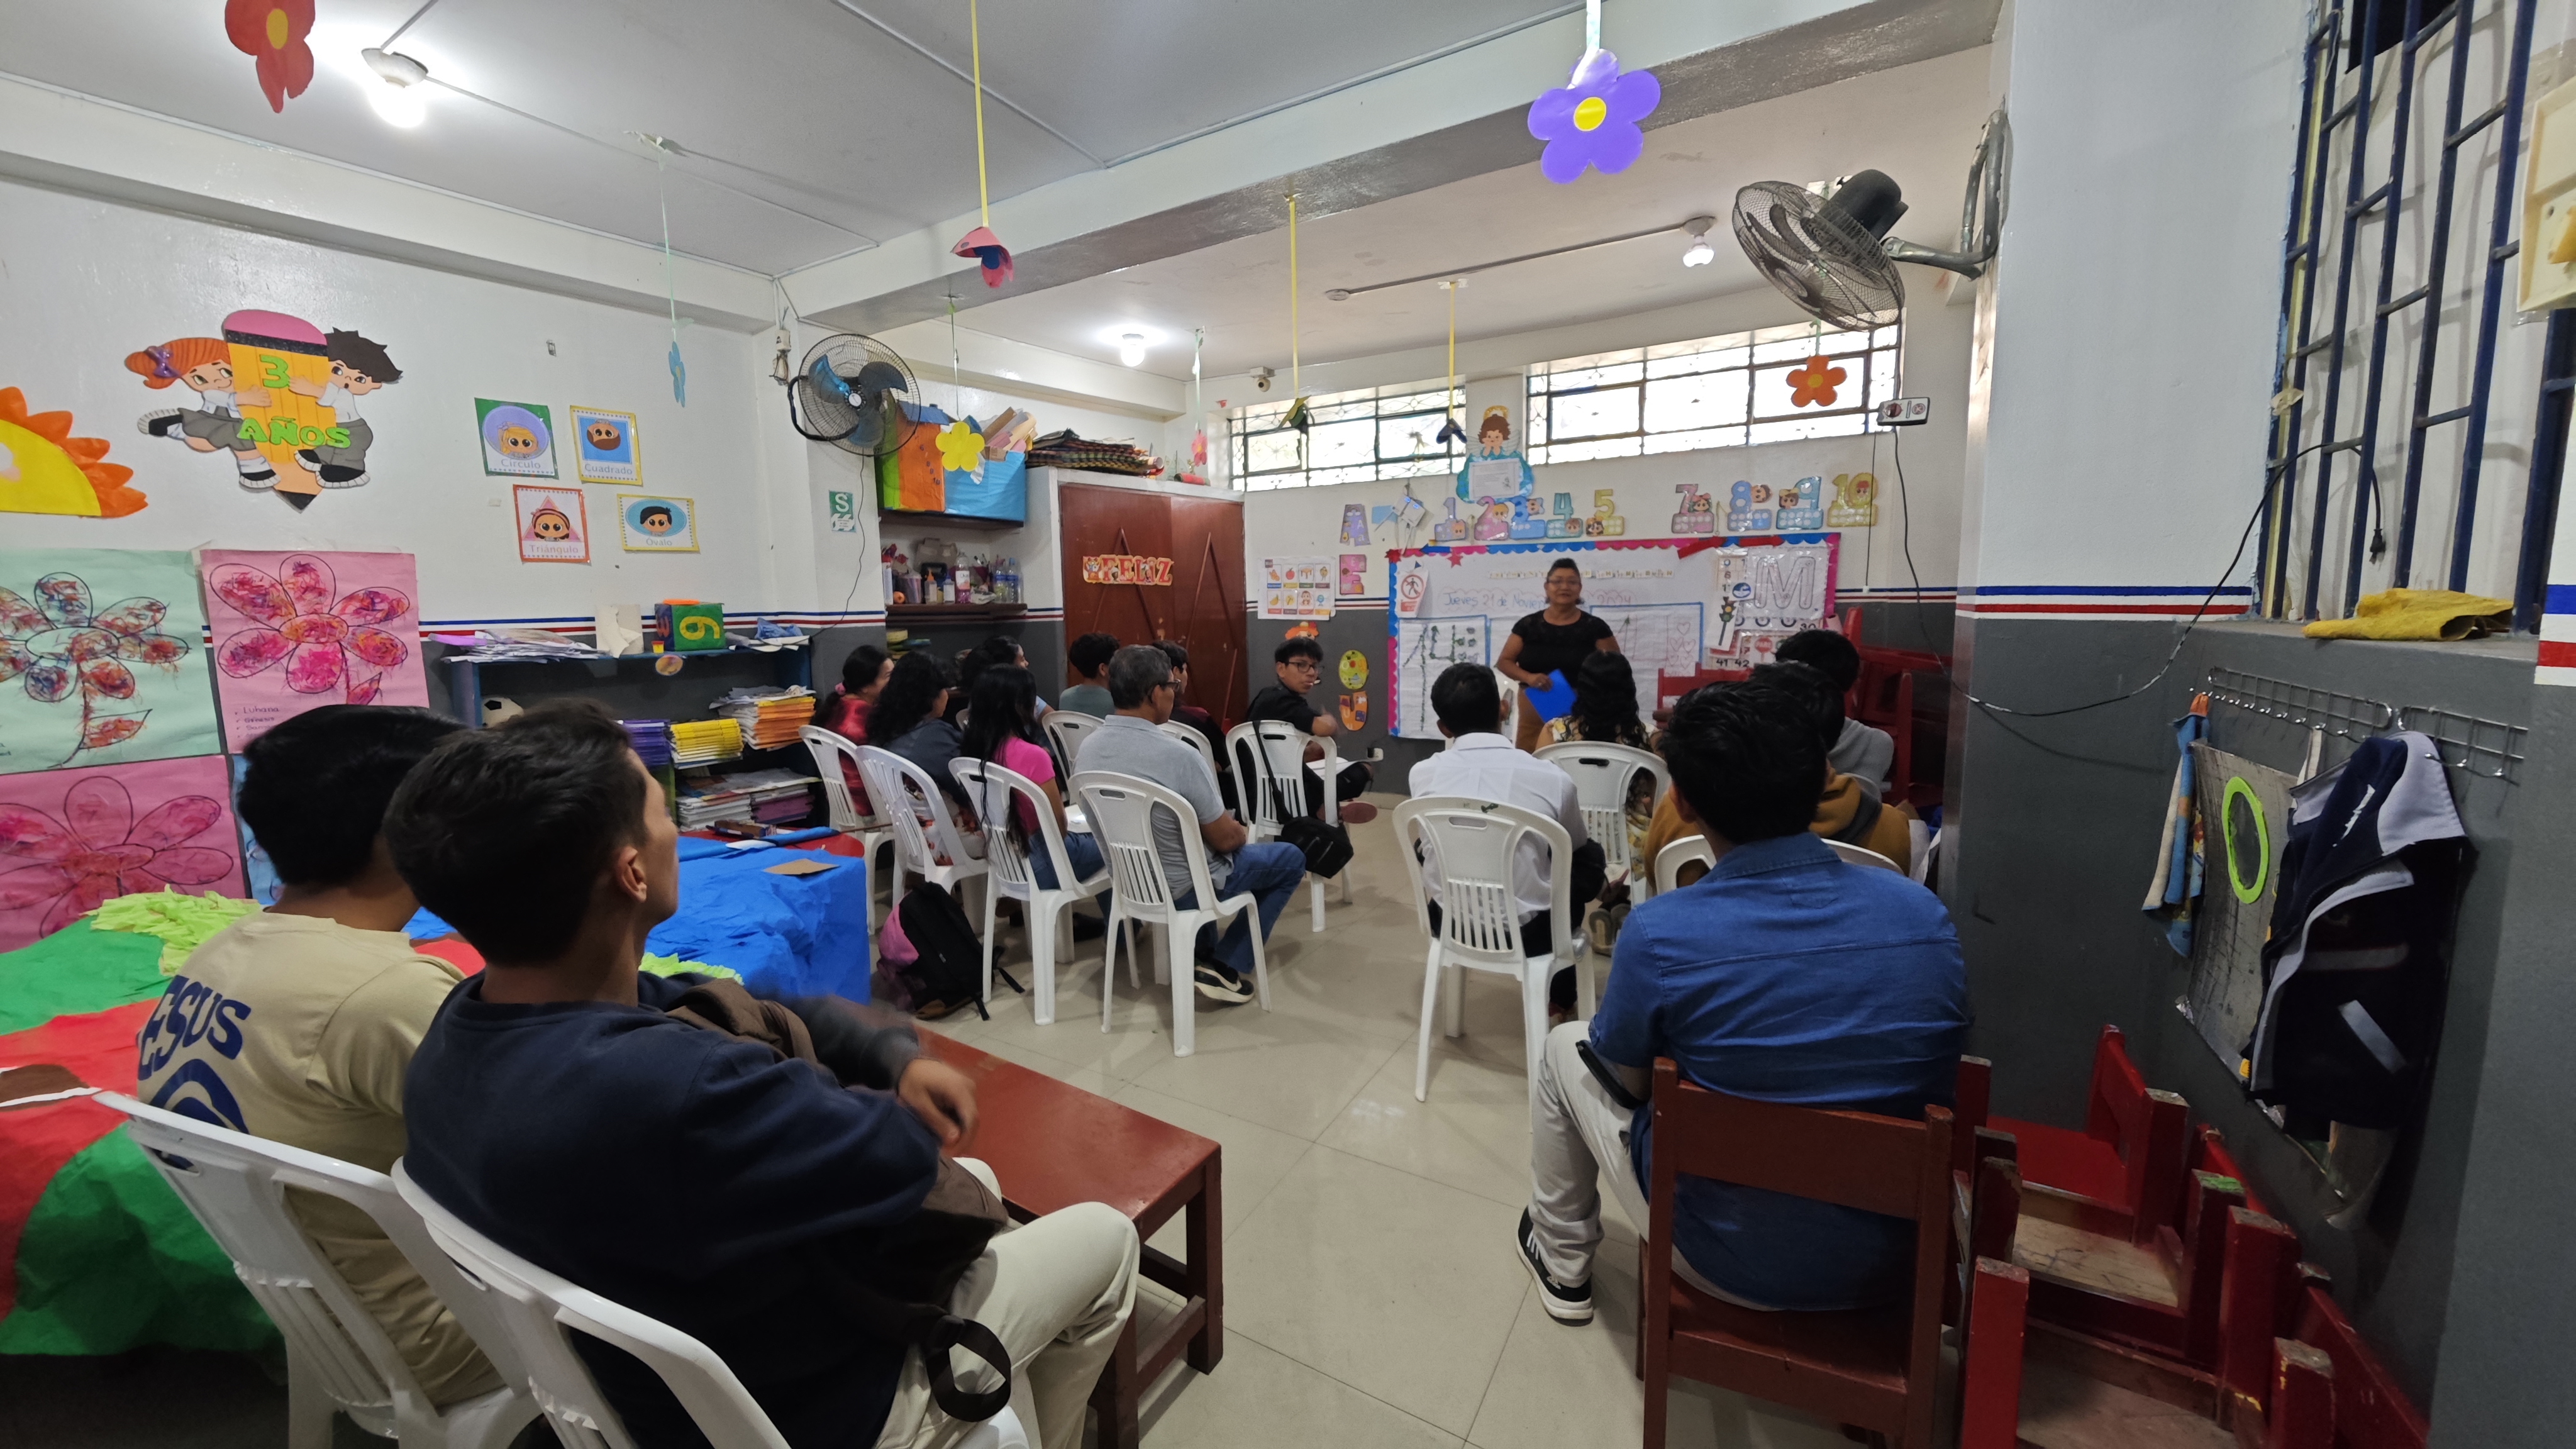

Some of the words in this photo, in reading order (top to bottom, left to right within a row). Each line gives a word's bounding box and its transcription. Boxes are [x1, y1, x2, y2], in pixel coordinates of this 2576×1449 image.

[259, 355, 291, 389] 3
[236, 416, 351, 448] AÑOS
[584, 464, 633, 475] Cuadrado
[835, 493, 850, 513] S
[529, 544, 579, 554] Triángulo
[646, 536, 673, 546] Óvalo
[1754, 556, 1816, 609] M
[1735, 659, 1750, 667] 42
[135, 974, 252, 1080] ESUS
